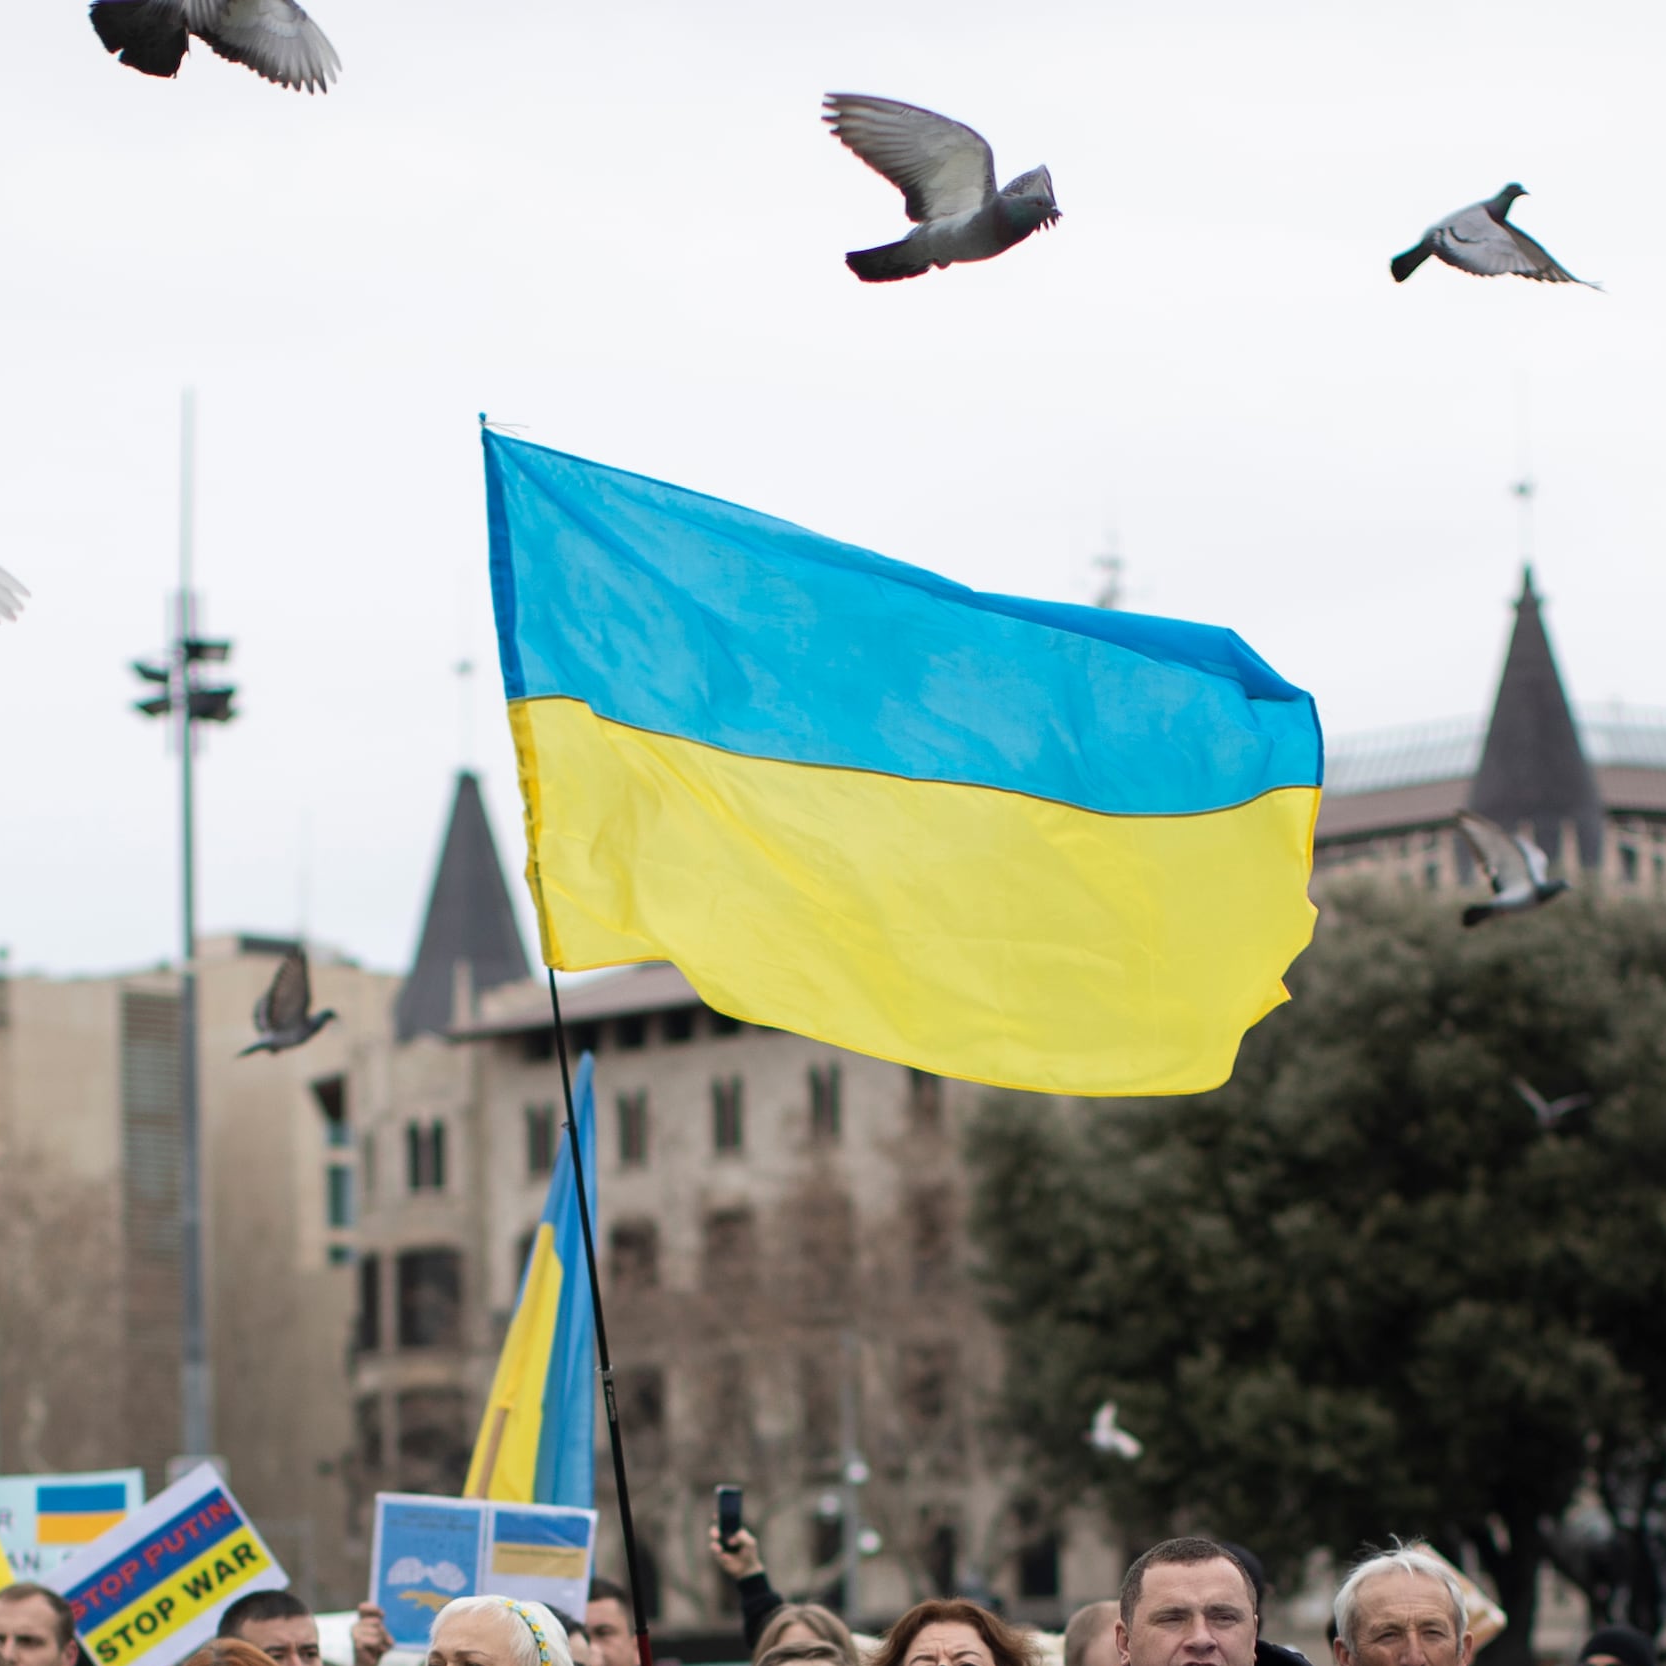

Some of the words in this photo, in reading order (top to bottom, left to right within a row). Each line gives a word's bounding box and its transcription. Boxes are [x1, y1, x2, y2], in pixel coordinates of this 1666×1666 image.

[70, 1559, 140, 1620] STOP
[143, 1497, 232, 1569] PUTIN
[95, 1596, 176, 1664] STOP
[181, 1541, 258, 1600] WAR
